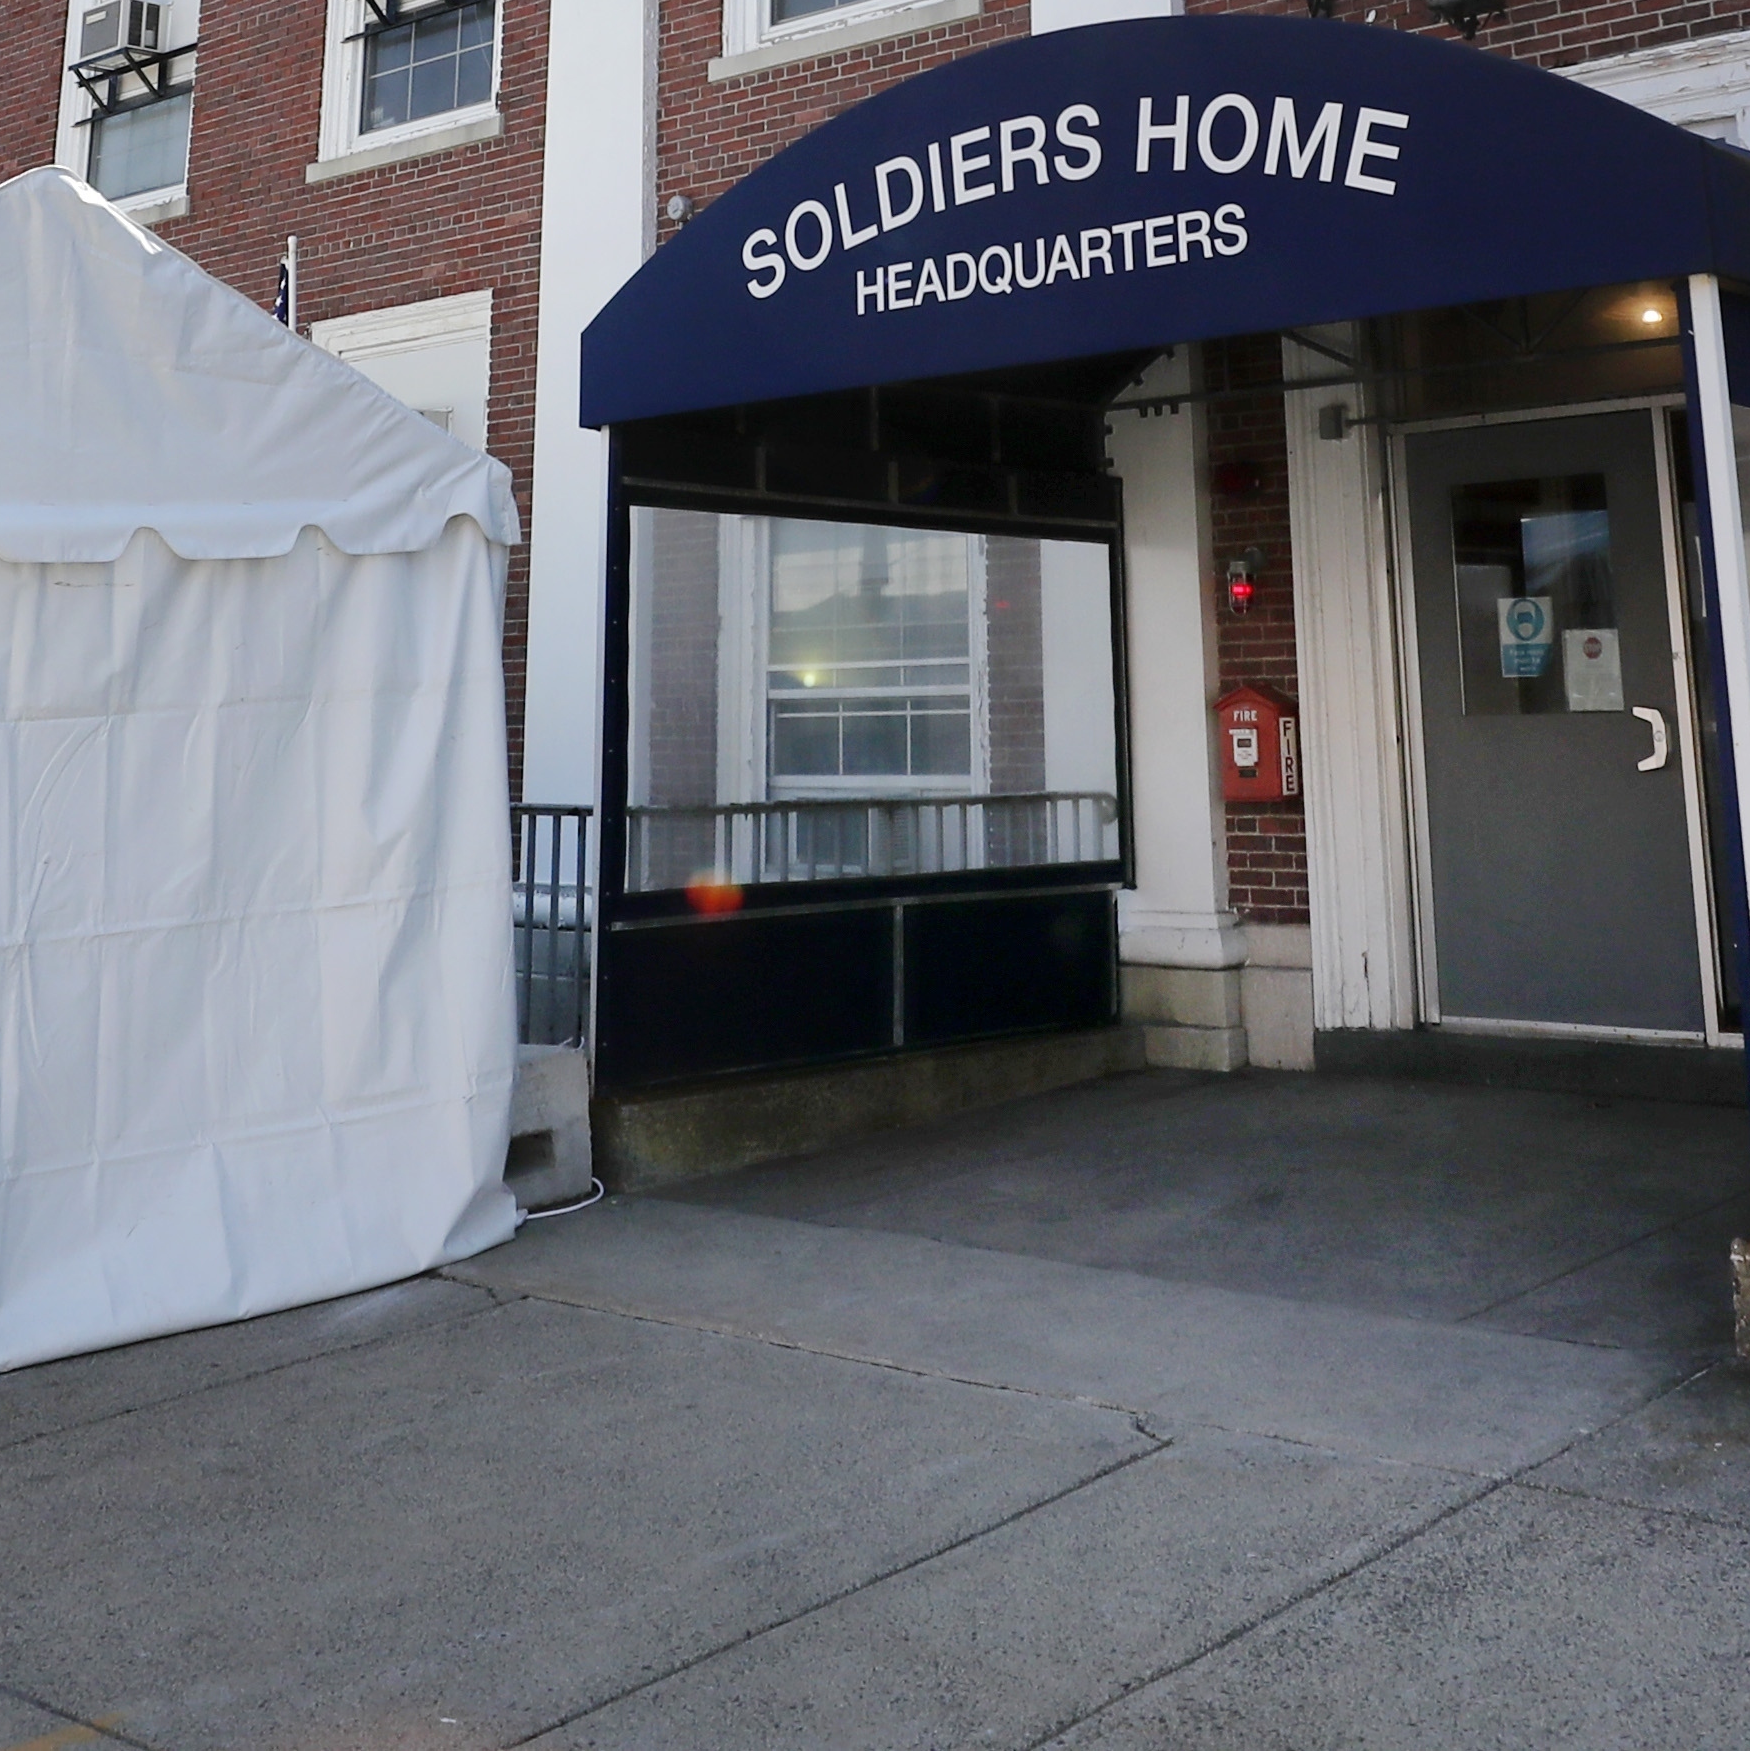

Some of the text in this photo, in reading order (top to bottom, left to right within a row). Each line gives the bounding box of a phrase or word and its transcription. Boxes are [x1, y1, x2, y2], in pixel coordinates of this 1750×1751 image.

[742, 93, 1410, 299] SOLDIERS HOME
[856, 203, 1248, 316] HEADQUARTERS
[1233, 710, 1258, 722] FIRE
[1283, 720, 1295, 792] FIRE
